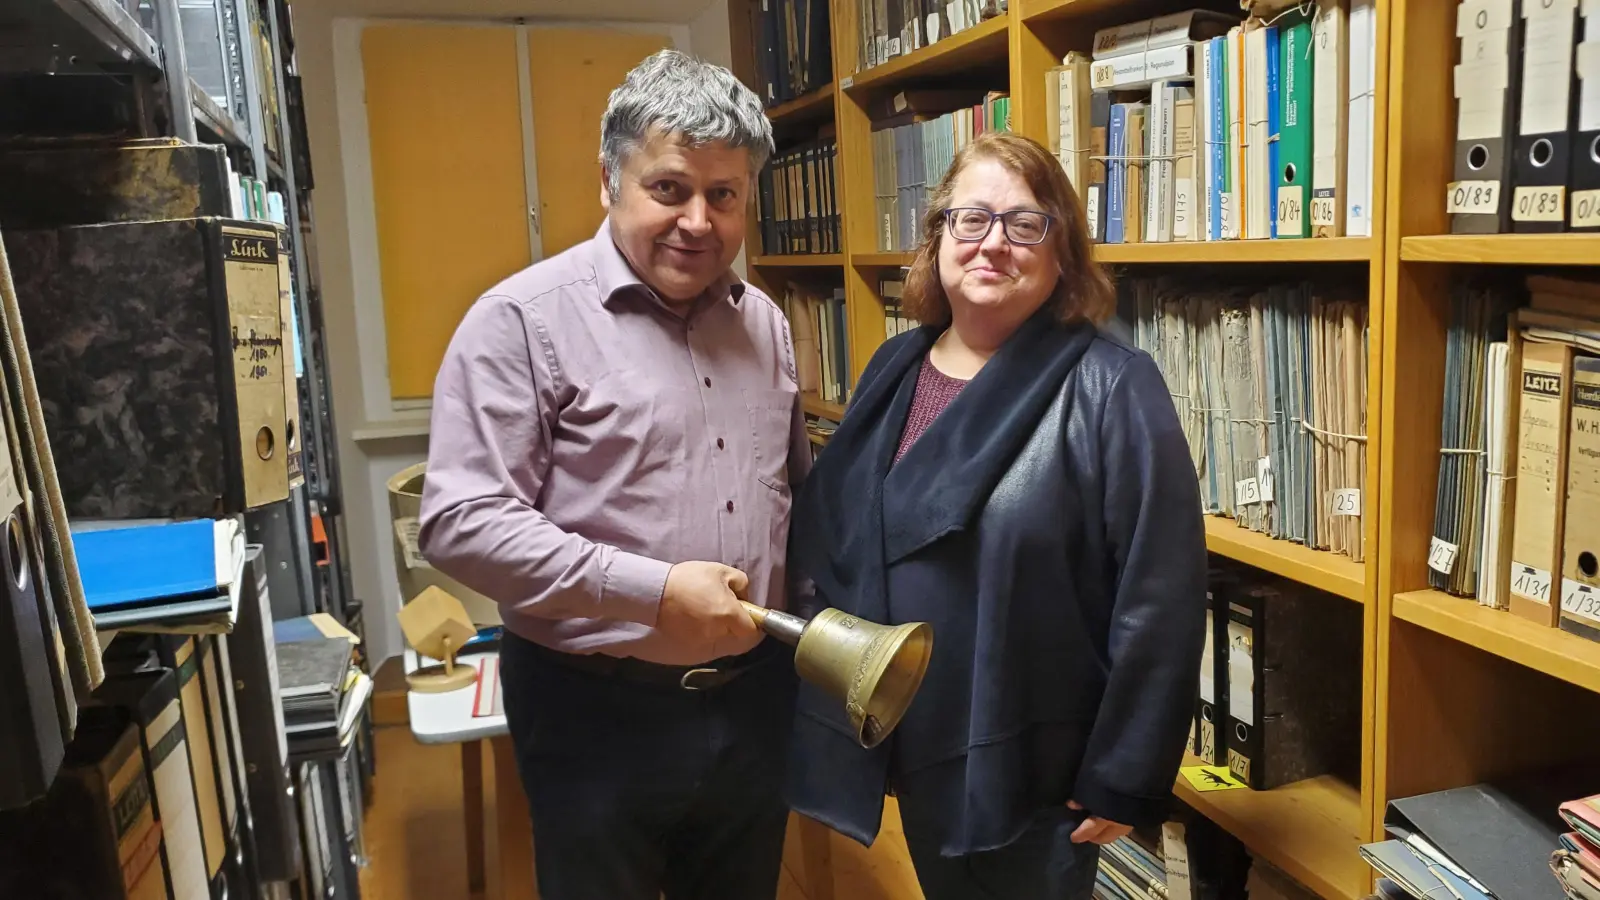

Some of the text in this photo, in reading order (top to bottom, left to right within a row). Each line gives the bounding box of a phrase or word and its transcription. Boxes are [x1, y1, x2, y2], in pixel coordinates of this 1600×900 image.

[1454, 186, 1493, 207] 0/89
[1519, 193, 1558, 216] 0/89
[1279, 198, 1300, 223] 0/84
[231, 239, 269, 258] Link
[1525, 375, 1560, 392] LEITZ
[1515, 576, 1549, 599] 1/31
[1565, 593, 1600, 617] 1/32
